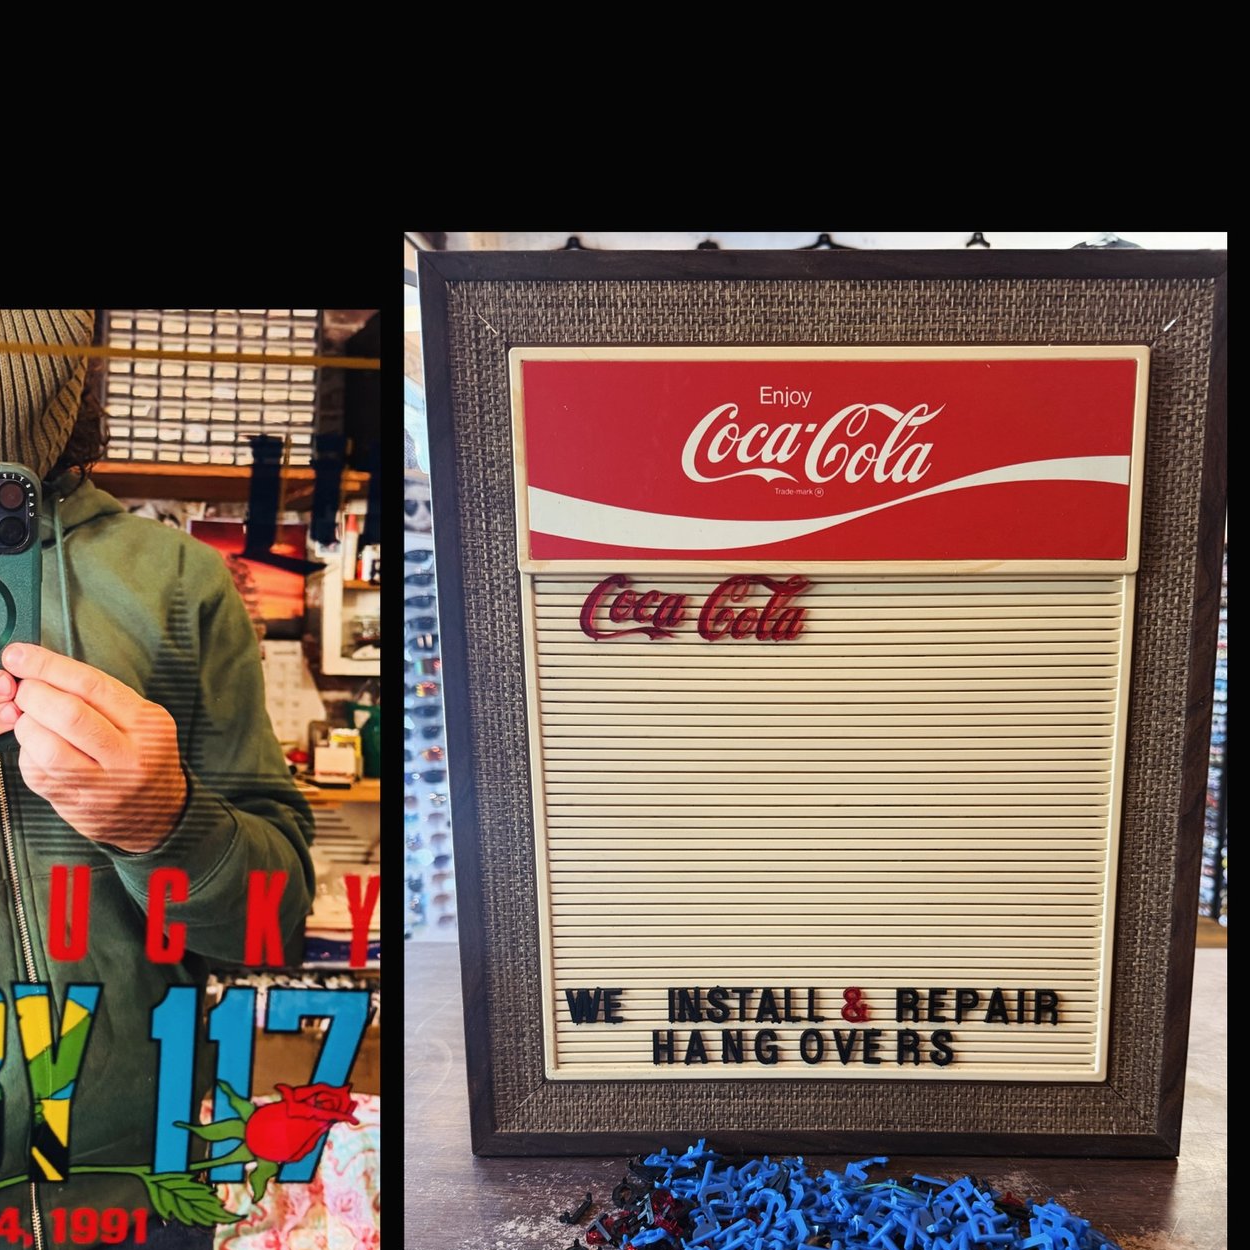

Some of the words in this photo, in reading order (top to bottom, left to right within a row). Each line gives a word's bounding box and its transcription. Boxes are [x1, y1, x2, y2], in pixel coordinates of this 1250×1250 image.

[759, 386, 812, 408] Enjoy
[681, 402, 947, 484] Coca-Cola
[579, 573, 688, 641] Coca
[697, 573, 812, 642] Cola
[564, 986, 625, 1025] WE
[668, 984, 825, 1025] INSTALL
[840, 986, 869, 1024] &
[895, 986, 1060, 1026] REPAIR
[149, 984, 373, 1184] 117
[52, 1206, 149, 1245] 1991
